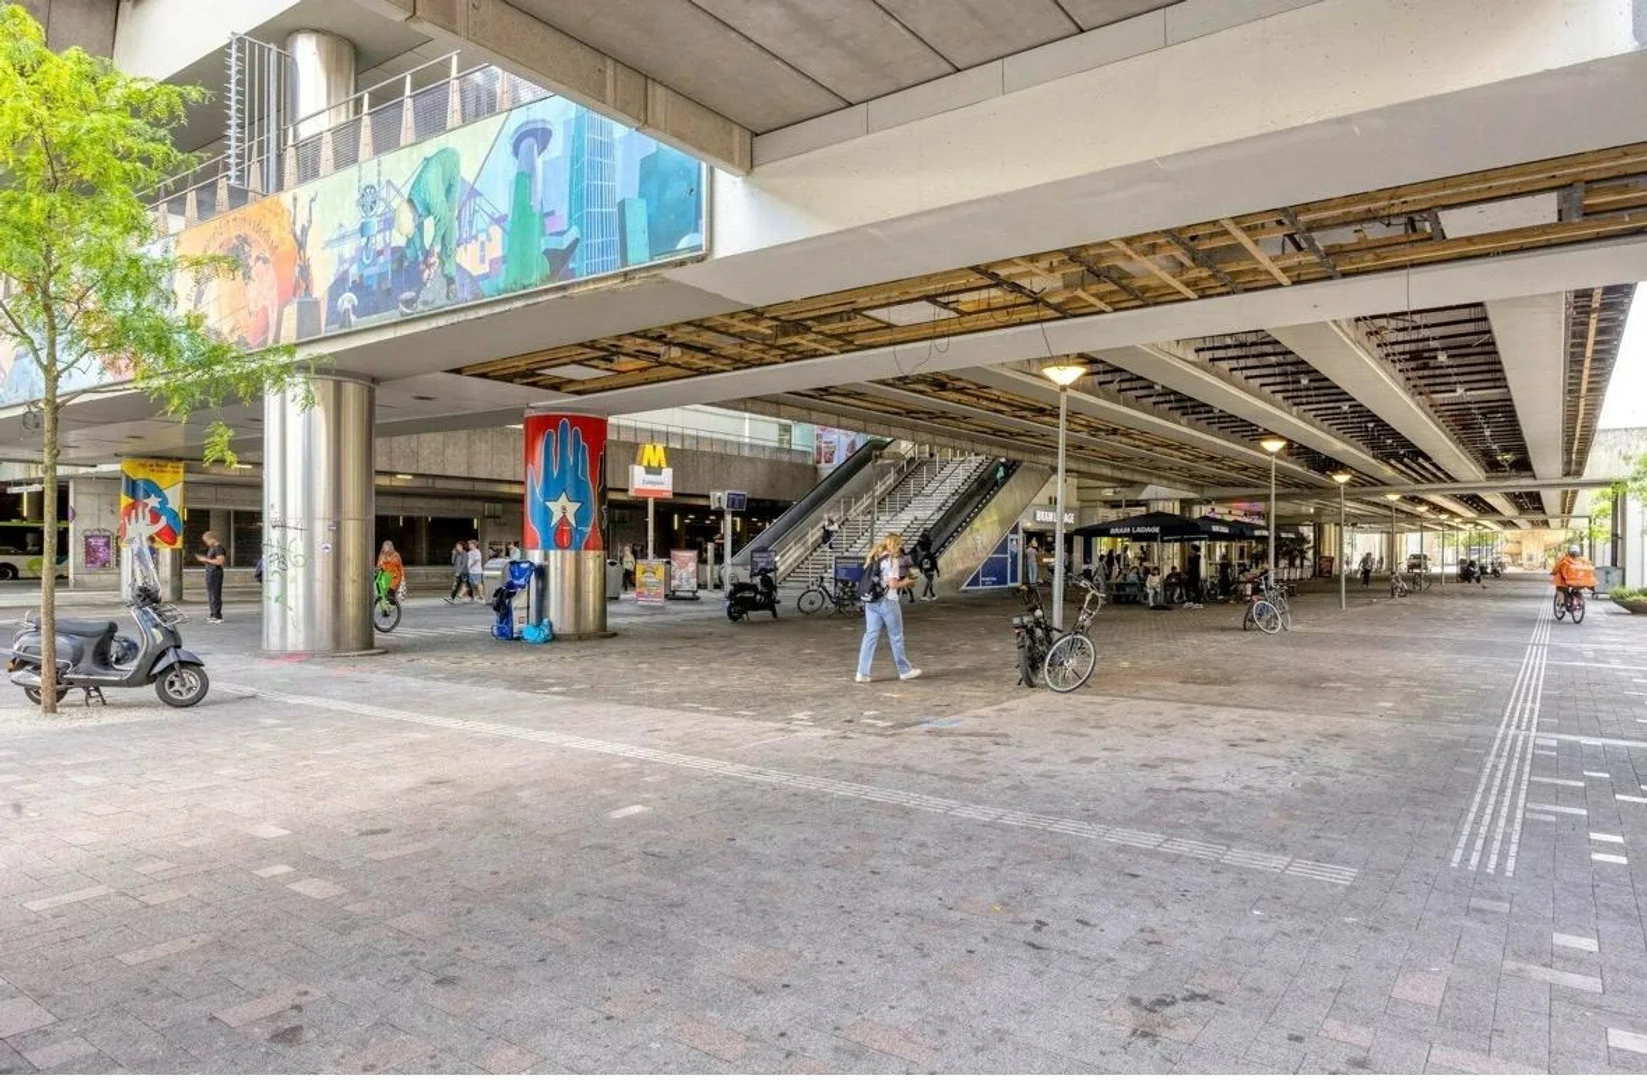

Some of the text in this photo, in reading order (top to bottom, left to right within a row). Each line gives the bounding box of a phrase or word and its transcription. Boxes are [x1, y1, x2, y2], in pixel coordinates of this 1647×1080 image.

[642, 444, 667, 468] M
[1110, 525, 1160, 534] BRAM LADAGE
